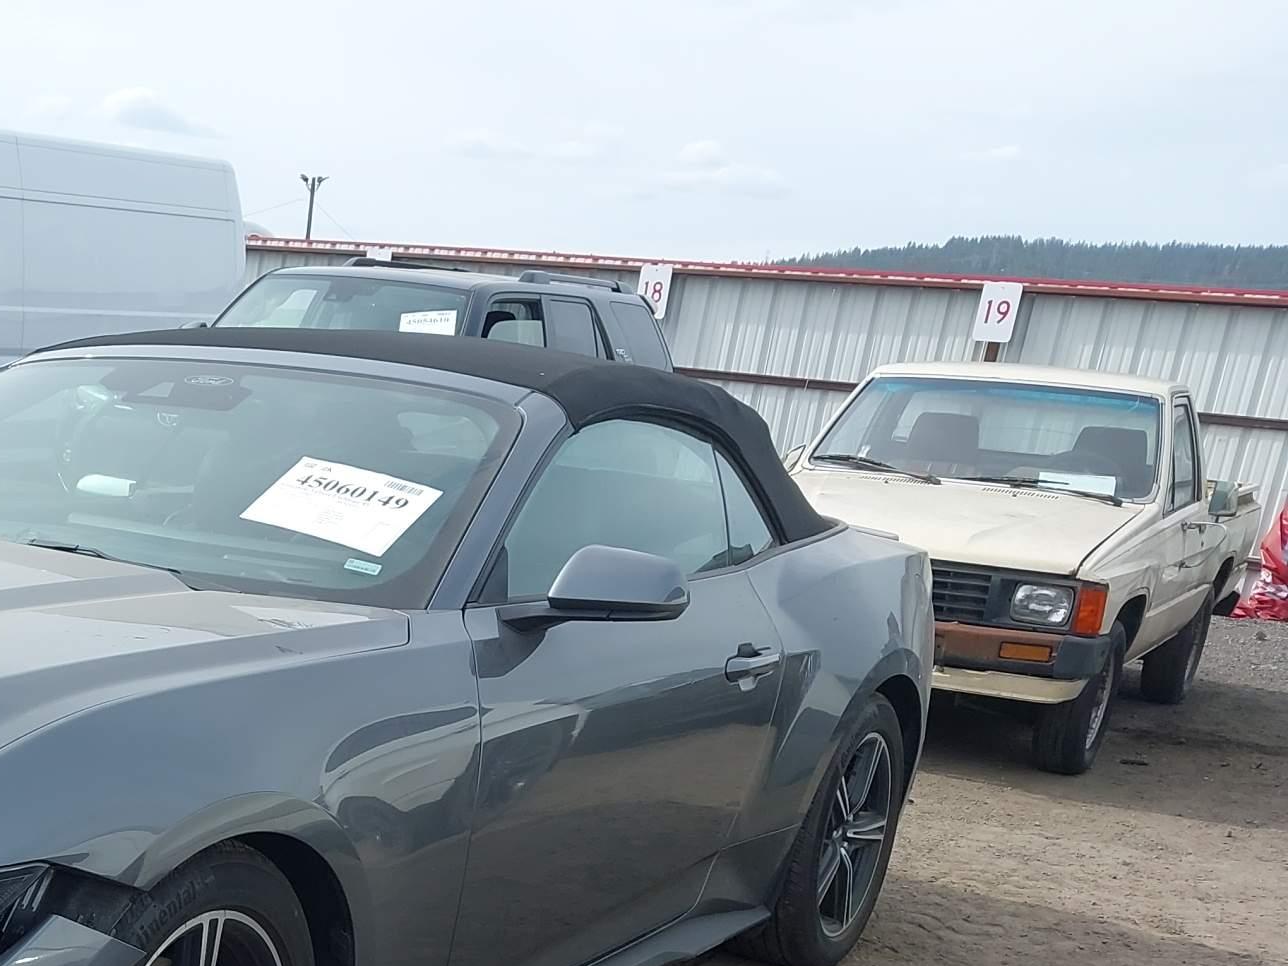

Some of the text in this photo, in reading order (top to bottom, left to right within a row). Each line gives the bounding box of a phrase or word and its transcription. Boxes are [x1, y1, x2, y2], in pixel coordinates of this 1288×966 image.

[643, 280, 663, 304] 18
[983, 299, 1011, 325] 19
[296, 474, 409, 510] 45060149
